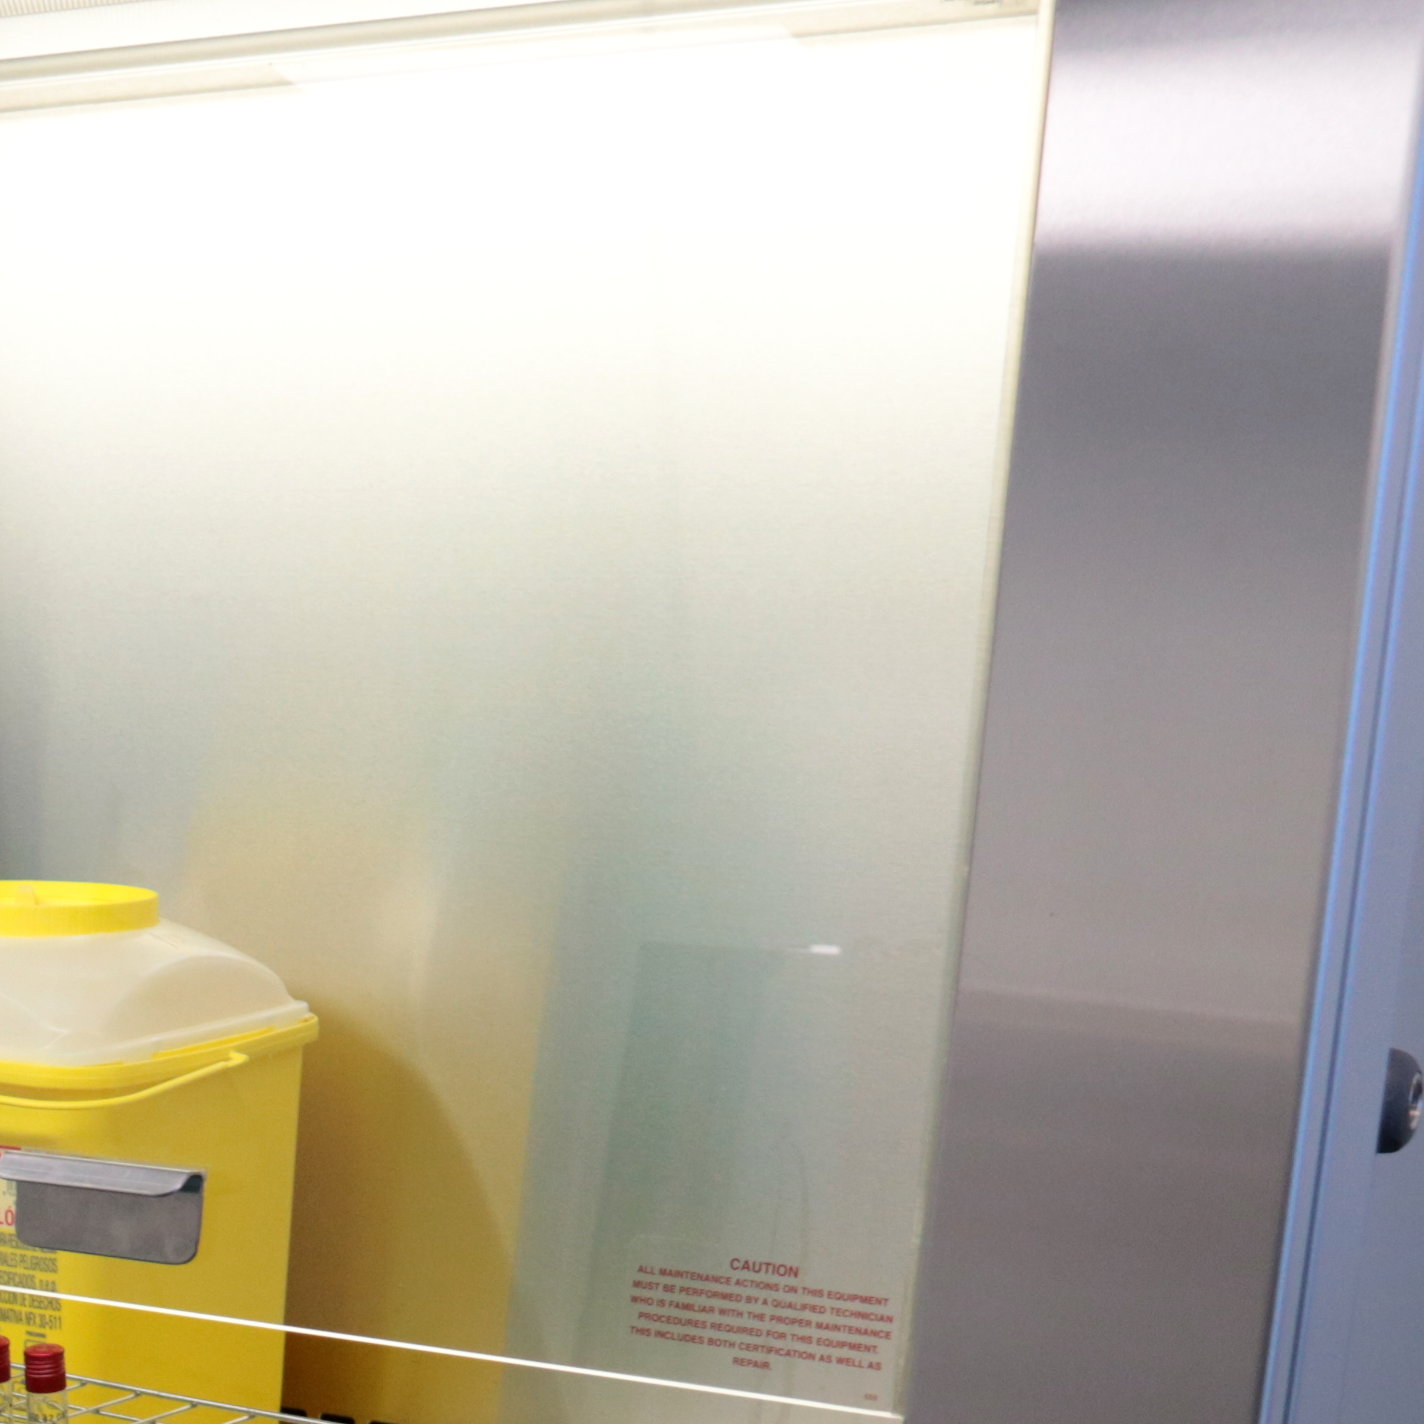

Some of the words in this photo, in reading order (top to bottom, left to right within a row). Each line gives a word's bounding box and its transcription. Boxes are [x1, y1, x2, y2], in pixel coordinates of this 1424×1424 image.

[637, 1265, 656, 1275] ALL
[659, 1267, 732, 1285] MAINTENANCE
[735, 1278, 780, 1292] ACTIONS
[783, 1284, 798, 1294] ON
[802, 1286, 824, 1298] THIS
[827, 1290, 890, 1307] EQUIPMENT
[730, 1258, 799, 1278] CAUTION
[630, 1295, 654, 1306] WHO
[656, 1298, 666, 1308] IS
[668, 1300, 716, 1313] FAMILIAR
[718, 1307, 744, 1318] WITH
[747, 1311, 766, 1322] THE
[769, 1314, 812, 1328] PROPER
[815, 1321, 892, 1340] MAINTENANCE
[632, 1280, 660, 1290] MUST
[662, 1284, 677, 1293] BE
[679, 1286, 743, 1302] PERFORMED
[745, 1295, 759, 1304] BY
[761, 1298, 769, 1306] A
[771, 1299, 826, 1314] QUALIFIED
[830, 1307, 894, 1323] TECHNICIAN
[630, 1326, 652, 1337] THIS
[654, 1330, 705, 1344] INCLUDES
[707, 1337, 736, 1348] BOTH
[738, 1342, 816, 1361] CERTIFICATION
[818, 1354, 833, 1363] AS
[835, 1356, 865, 1369] WELL
[867, 1361, 882, 1371] AS
[638, 1311, 707, 1329] PROCEDURES
[710, 1322, 763, 1337] REQUIRED
[766, 1330, 787, 1340] FOR
[790, 1333, 814, 1345] THIS
